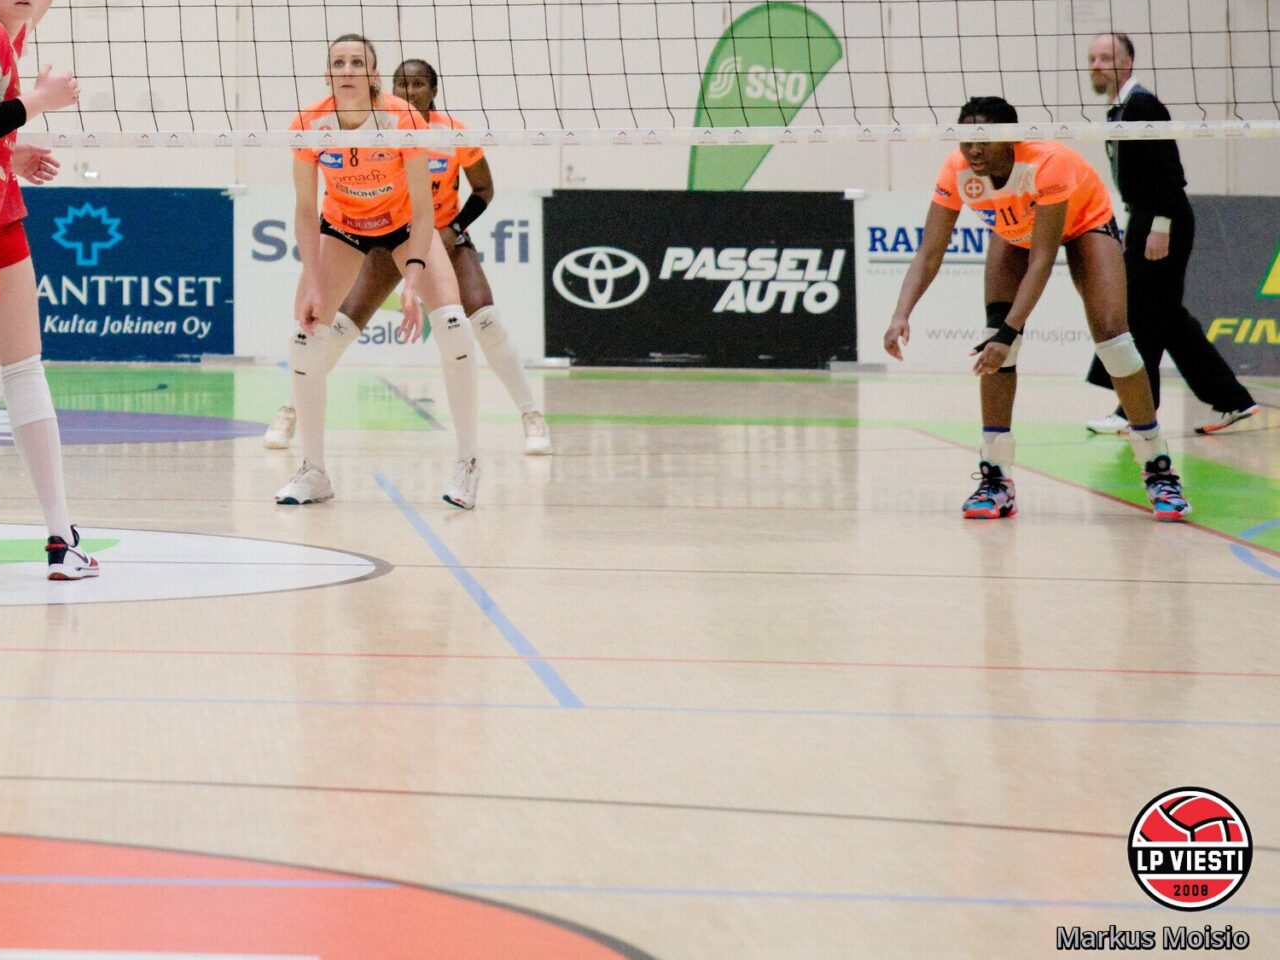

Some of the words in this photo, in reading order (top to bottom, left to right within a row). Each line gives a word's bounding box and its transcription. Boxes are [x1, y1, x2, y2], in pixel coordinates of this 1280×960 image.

[745, 65, 807, 103] SSO
[999, 206, 1018, 226] 11
[659, 247, 847, 281] PASSELI
[37, 275, 222, 306] ANTTISET
[712, 281, 841, 314] AUTO
[44, 314, 98, 334] Kulta
[100, 314, 176, 336] Jokinen
[182, 316, 212, 339] Oy
